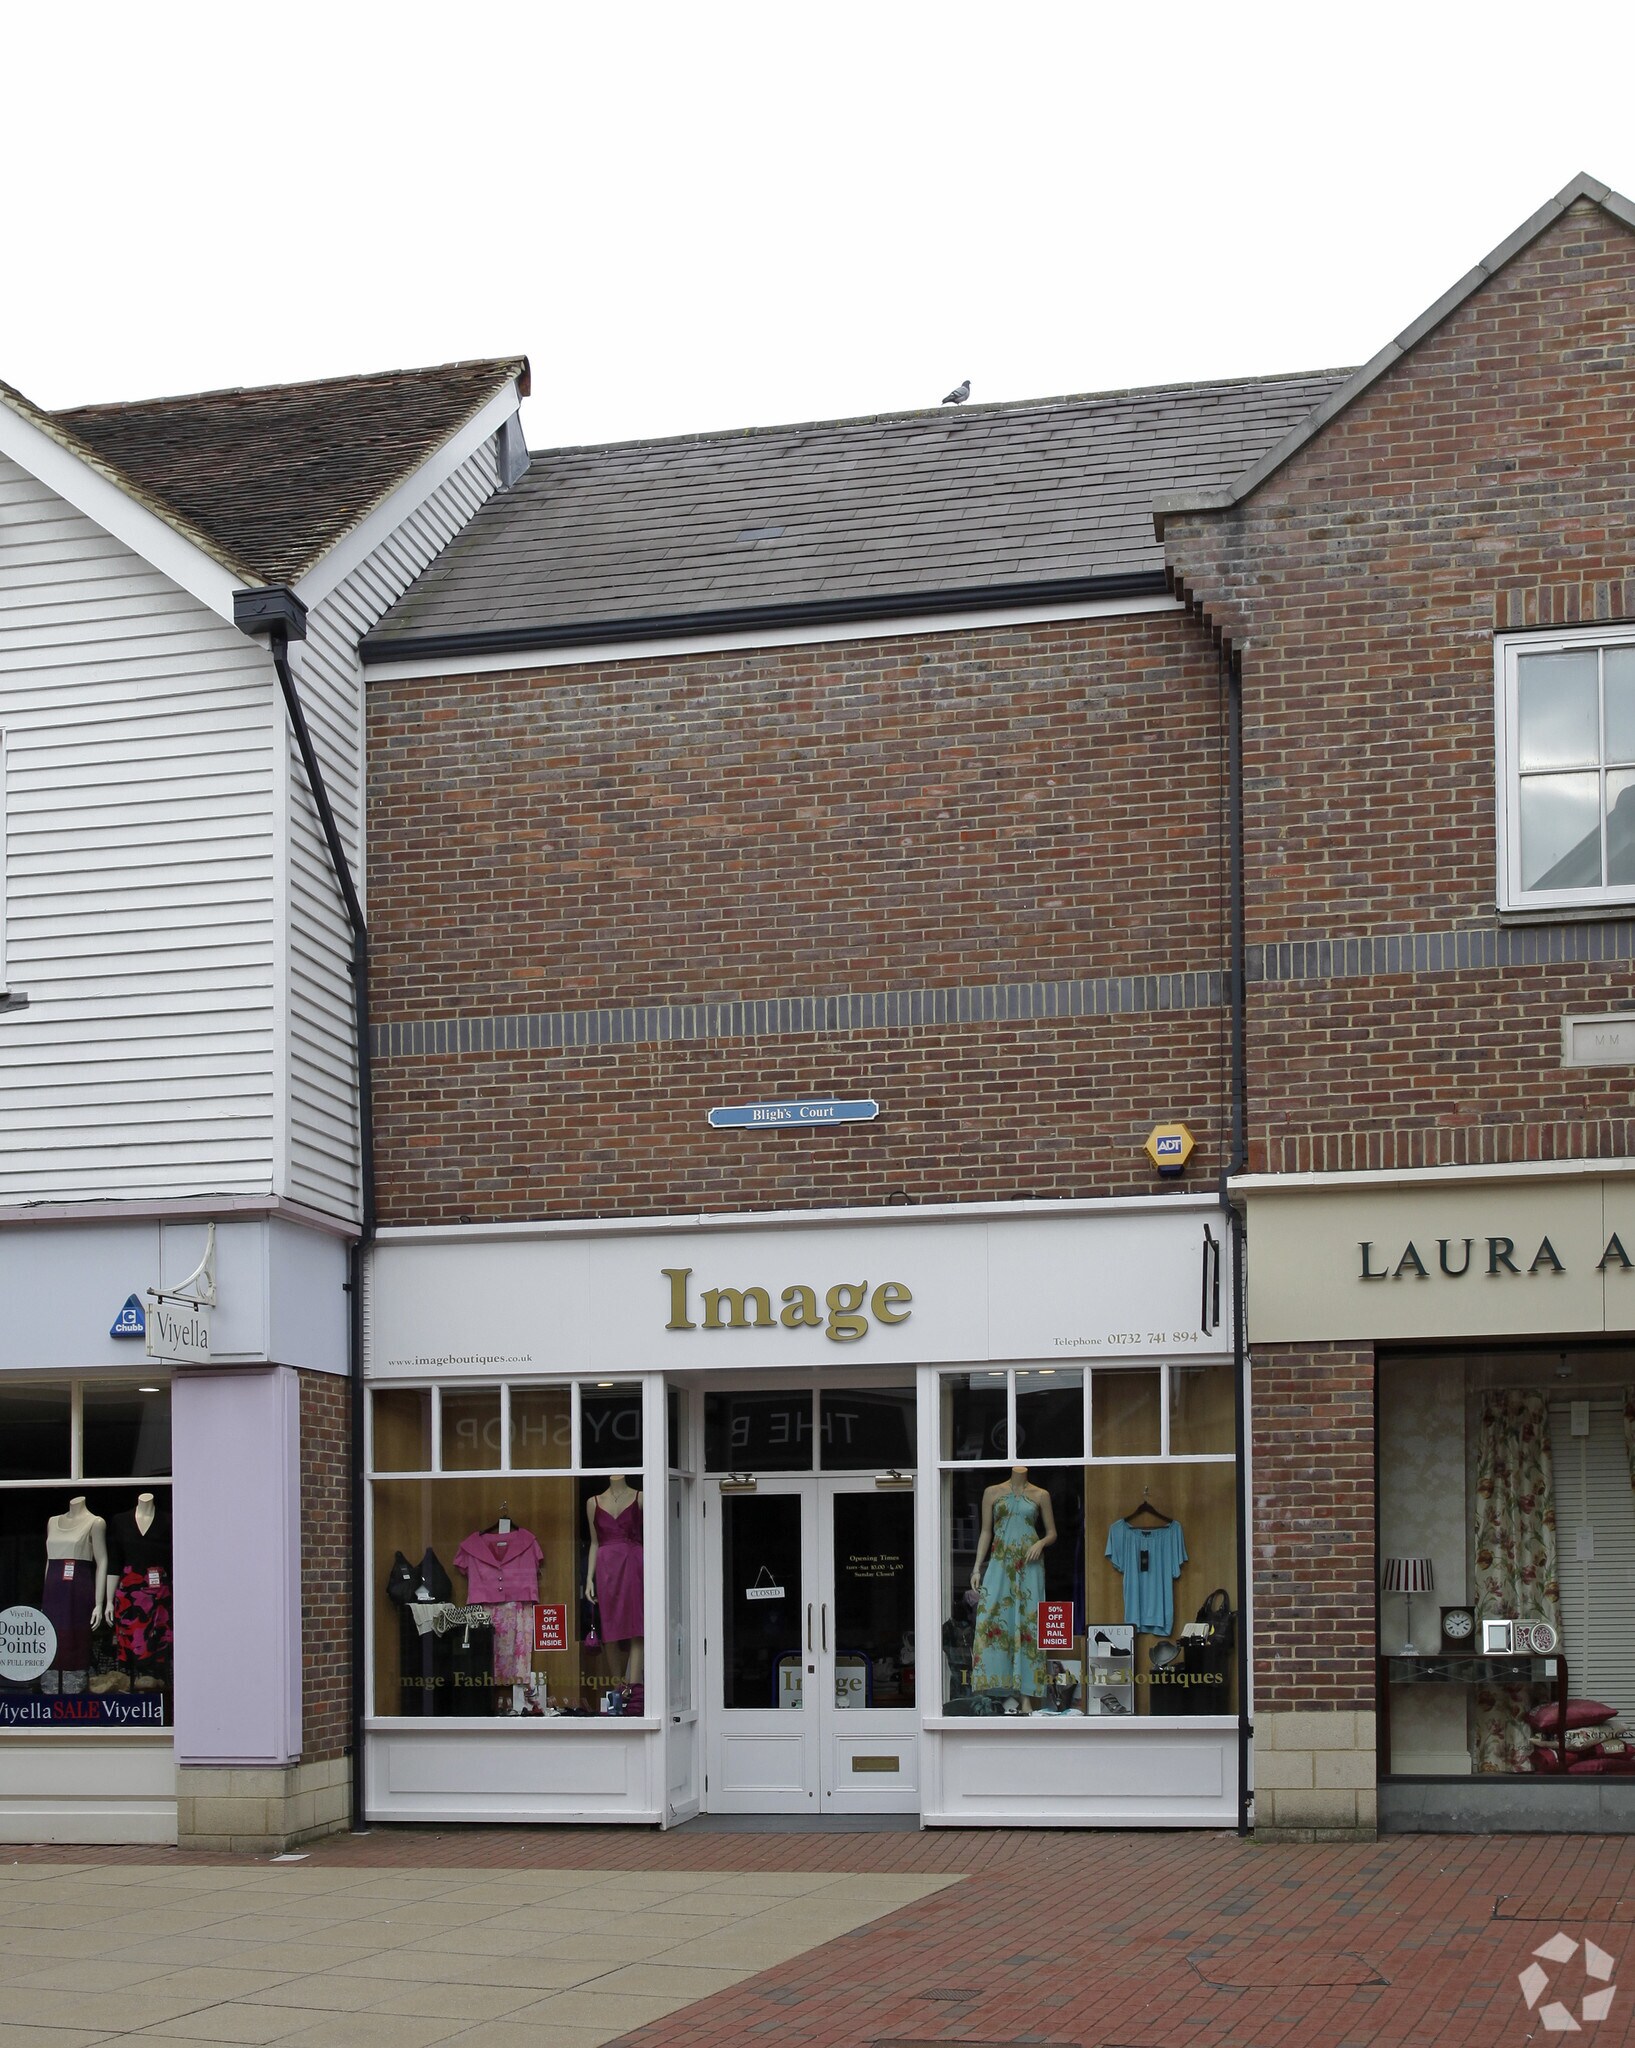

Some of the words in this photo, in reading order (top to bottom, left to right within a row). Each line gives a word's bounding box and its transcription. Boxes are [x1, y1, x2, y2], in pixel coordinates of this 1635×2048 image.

[753, 1108, 792, 1121] Bligh's
[800, 1106, 835, 1118] Court
[1158, 1140, 1182, 1151] ADT
[1357, 1235, 1566, 1279] LAURA
[1595, 1231, 1635, 1269] A
[660, 1267, 913, 1342] Image
[115, 1323, 144, 1332] Chubb
[157, 1311, 208, 1352] Viyella
[1053, 1337, 1102, 1347] Telephone
[1107, 1333, 1142, 1345] 01732
[1147, 1332, 1166, 1344] 741
[1172, 1331, 1198, 1343] 894
[388, 1353, 533, 1367] www.imageboutiques.co.uk
[849, 1555, 878, 1563] Opening
[750, 1588, 781, 1597] CLOSED
[10, 1610, 33, 1619] Viyella
[0, 1621, 46, 1636] Double
[0, 1659, 6, 1667] N
[7, 1659, 23, 1667] FULL
[24, 1659, 45, 1667] PRICE
[397, 1673, 445, 1691] mage
[783, 1670, 862, 1697] Ige
[53, 1701, 100, 1719] SALE
[102, 1700, 162, 1723] Viyella
